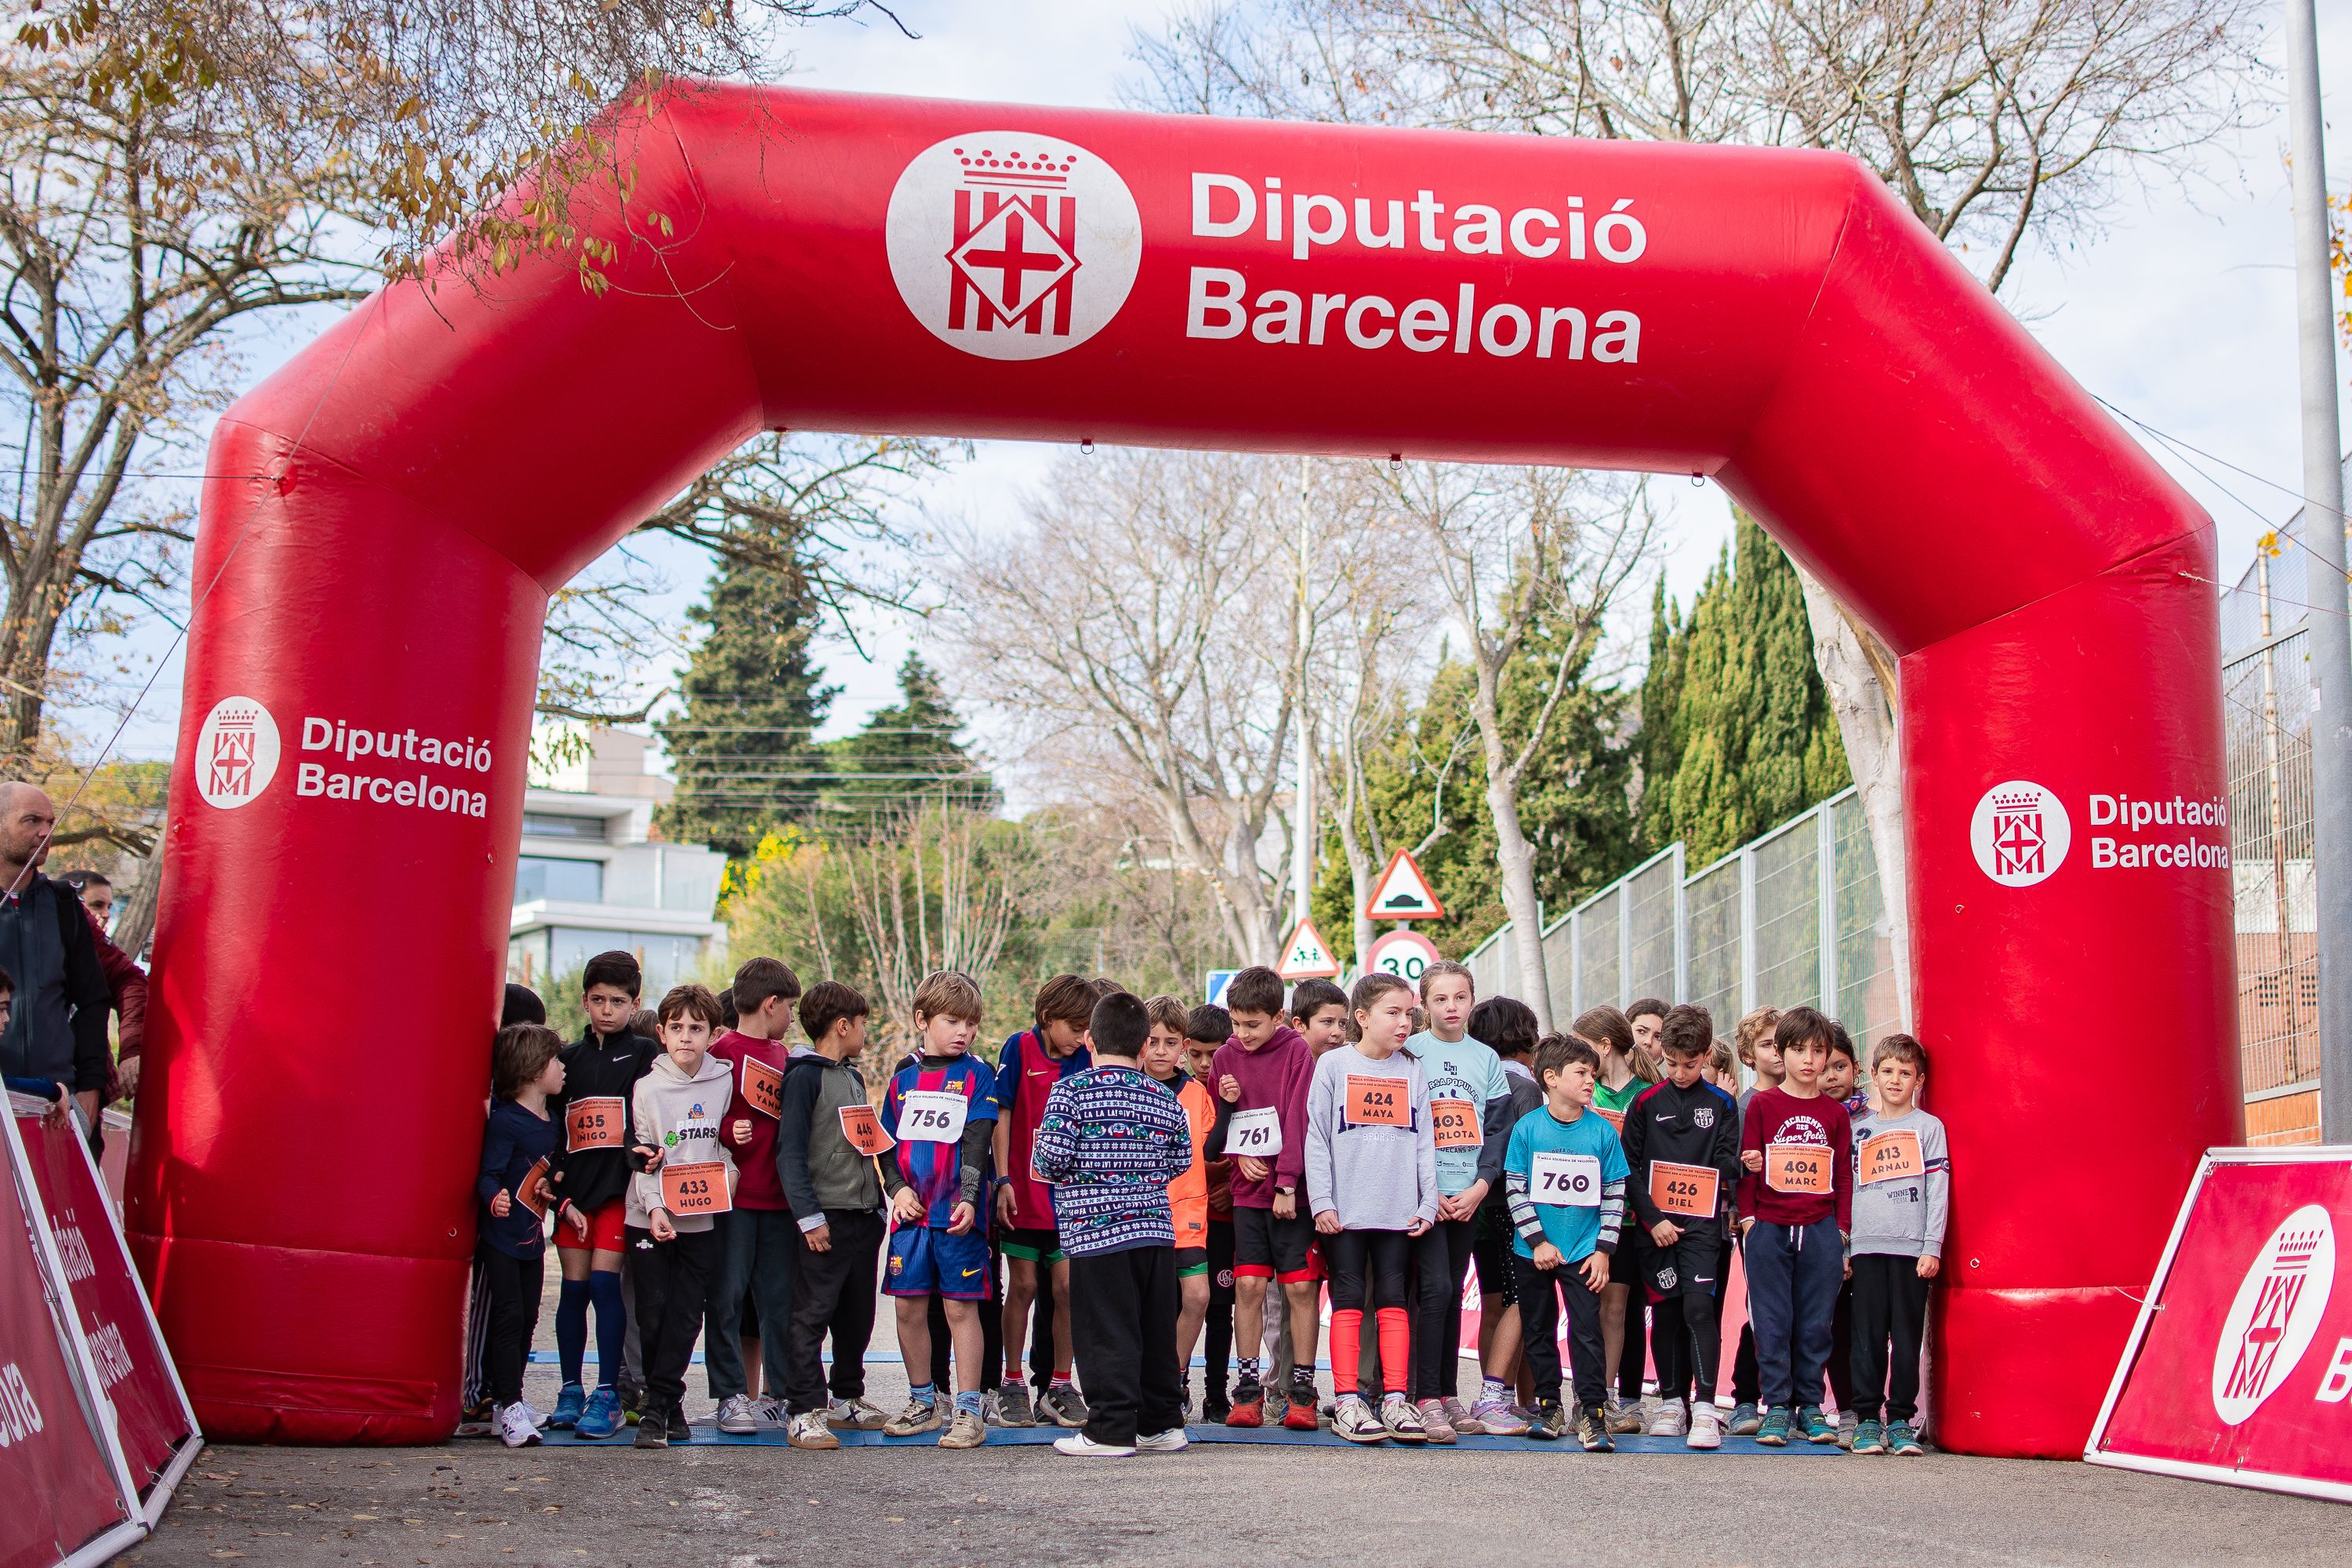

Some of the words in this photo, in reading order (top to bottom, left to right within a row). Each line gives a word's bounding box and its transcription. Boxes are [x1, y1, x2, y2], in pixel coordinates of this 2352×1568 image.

[1191, 172, 1646, 263] Diputació
[1186, 266, 1640, 364] Barcelona
[301, 717, 492, 773] Diputació
[296, 763, 487, 818] Barcelona
[2089, 794, 2226, 832] Diputació
[2091, 837, 2228, 869] Barcelona
[1382, 958, 1423, 979] 30
[1428, 1078, 1446, 1091] RSA
[1446, 1078, 1479, 1103] POPULAR
[1363, 1092, 1393, 1105] 424
[912, 1109, 950, 1128] 756
[1363, 1109, 1393, 1118] MAYA
[578, 1115, 604, 1129] 435
[1434, 1115, 1464, 1128] 403
[1784, 1116, 1822, 1129] ACADEMY
[577, 1131, 607, 1142] IÑIGO
[680, 1127, 717, 1140] STARS
[857, 1123, 872, 1136] 446
[1240, 1127, 1269, 1146] 761
[862, 1139, 873, 1148] PAU
[1773, 1134, 1802, 1145] Super
[1876, 1146, 1900, 1161] 413
[1784, 1161, 1817, 1174] 404
[1871, 1161, 1909, 1174] ARNAU
[680, 1180, 708, 1194] 433
[1544, 1172, 1589, 1192] 760
[1785, 1177, 1817, 1185] MARC
[1667, 1181, 1697, 1196] 426
[1887, 1187, 1918, 1203] WINNER
[680, 1197, 711, 1207] HUGO
[1668, 1197, 1693, 1207] BIEL
